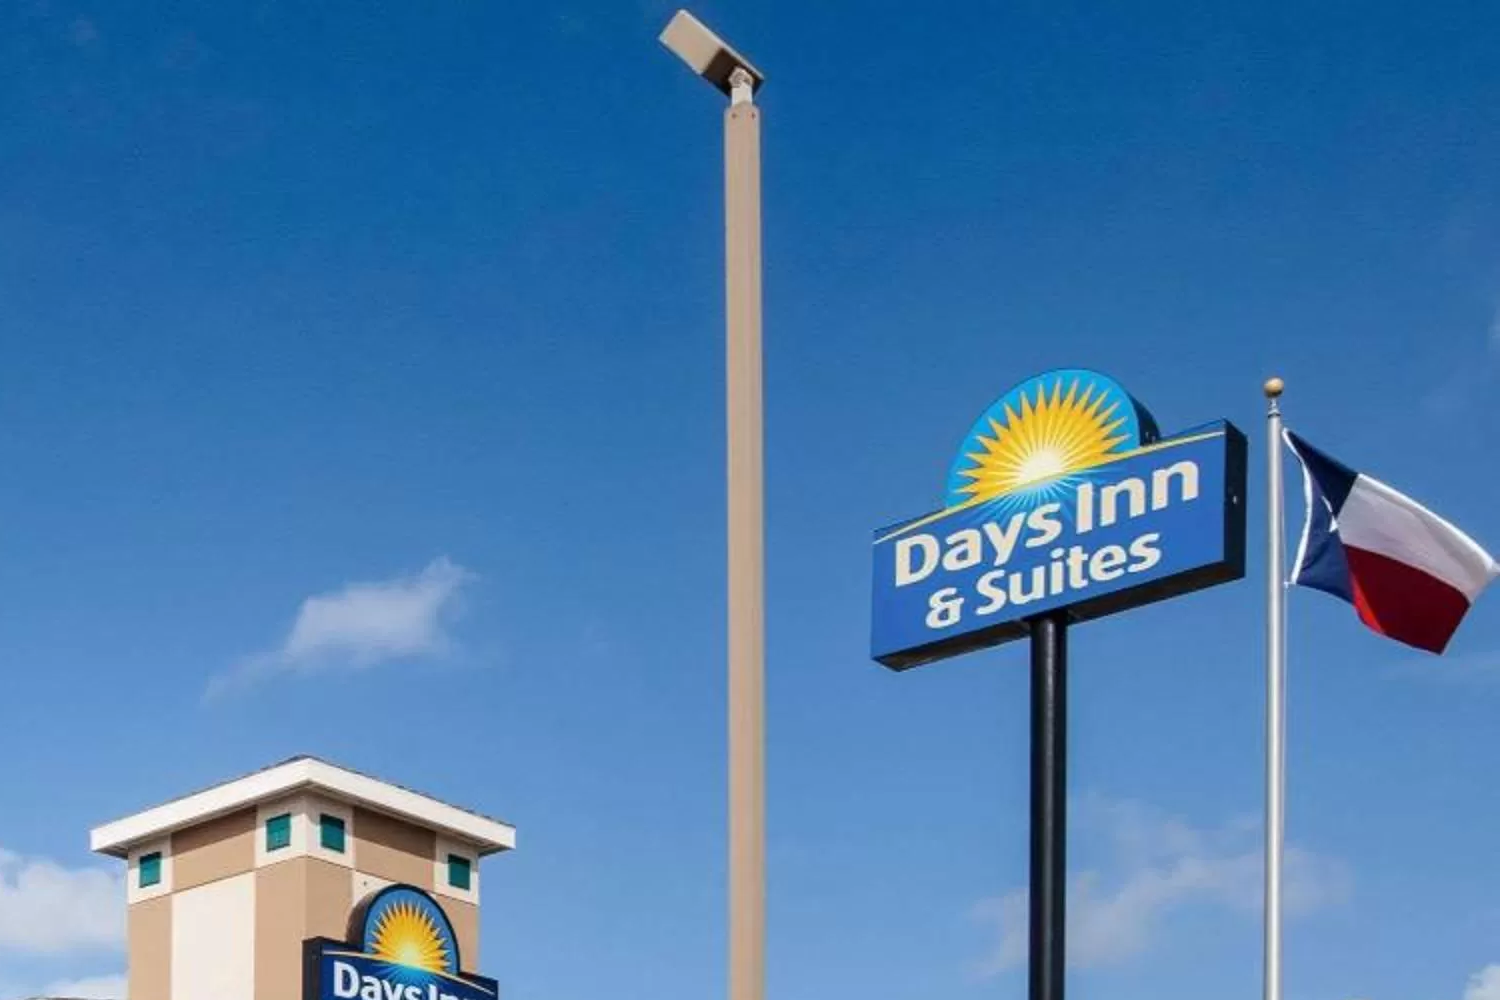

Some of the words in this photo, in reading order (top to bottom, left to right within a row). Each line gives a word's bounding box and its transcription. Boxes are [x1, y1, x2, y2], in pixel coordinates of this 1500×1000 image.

[895, 503, 1060, 587] Days
[1076, 460, 1199, 535] Inn
[925, 586, 964, 629] &
[975, 532, 1161, 616] Suites
